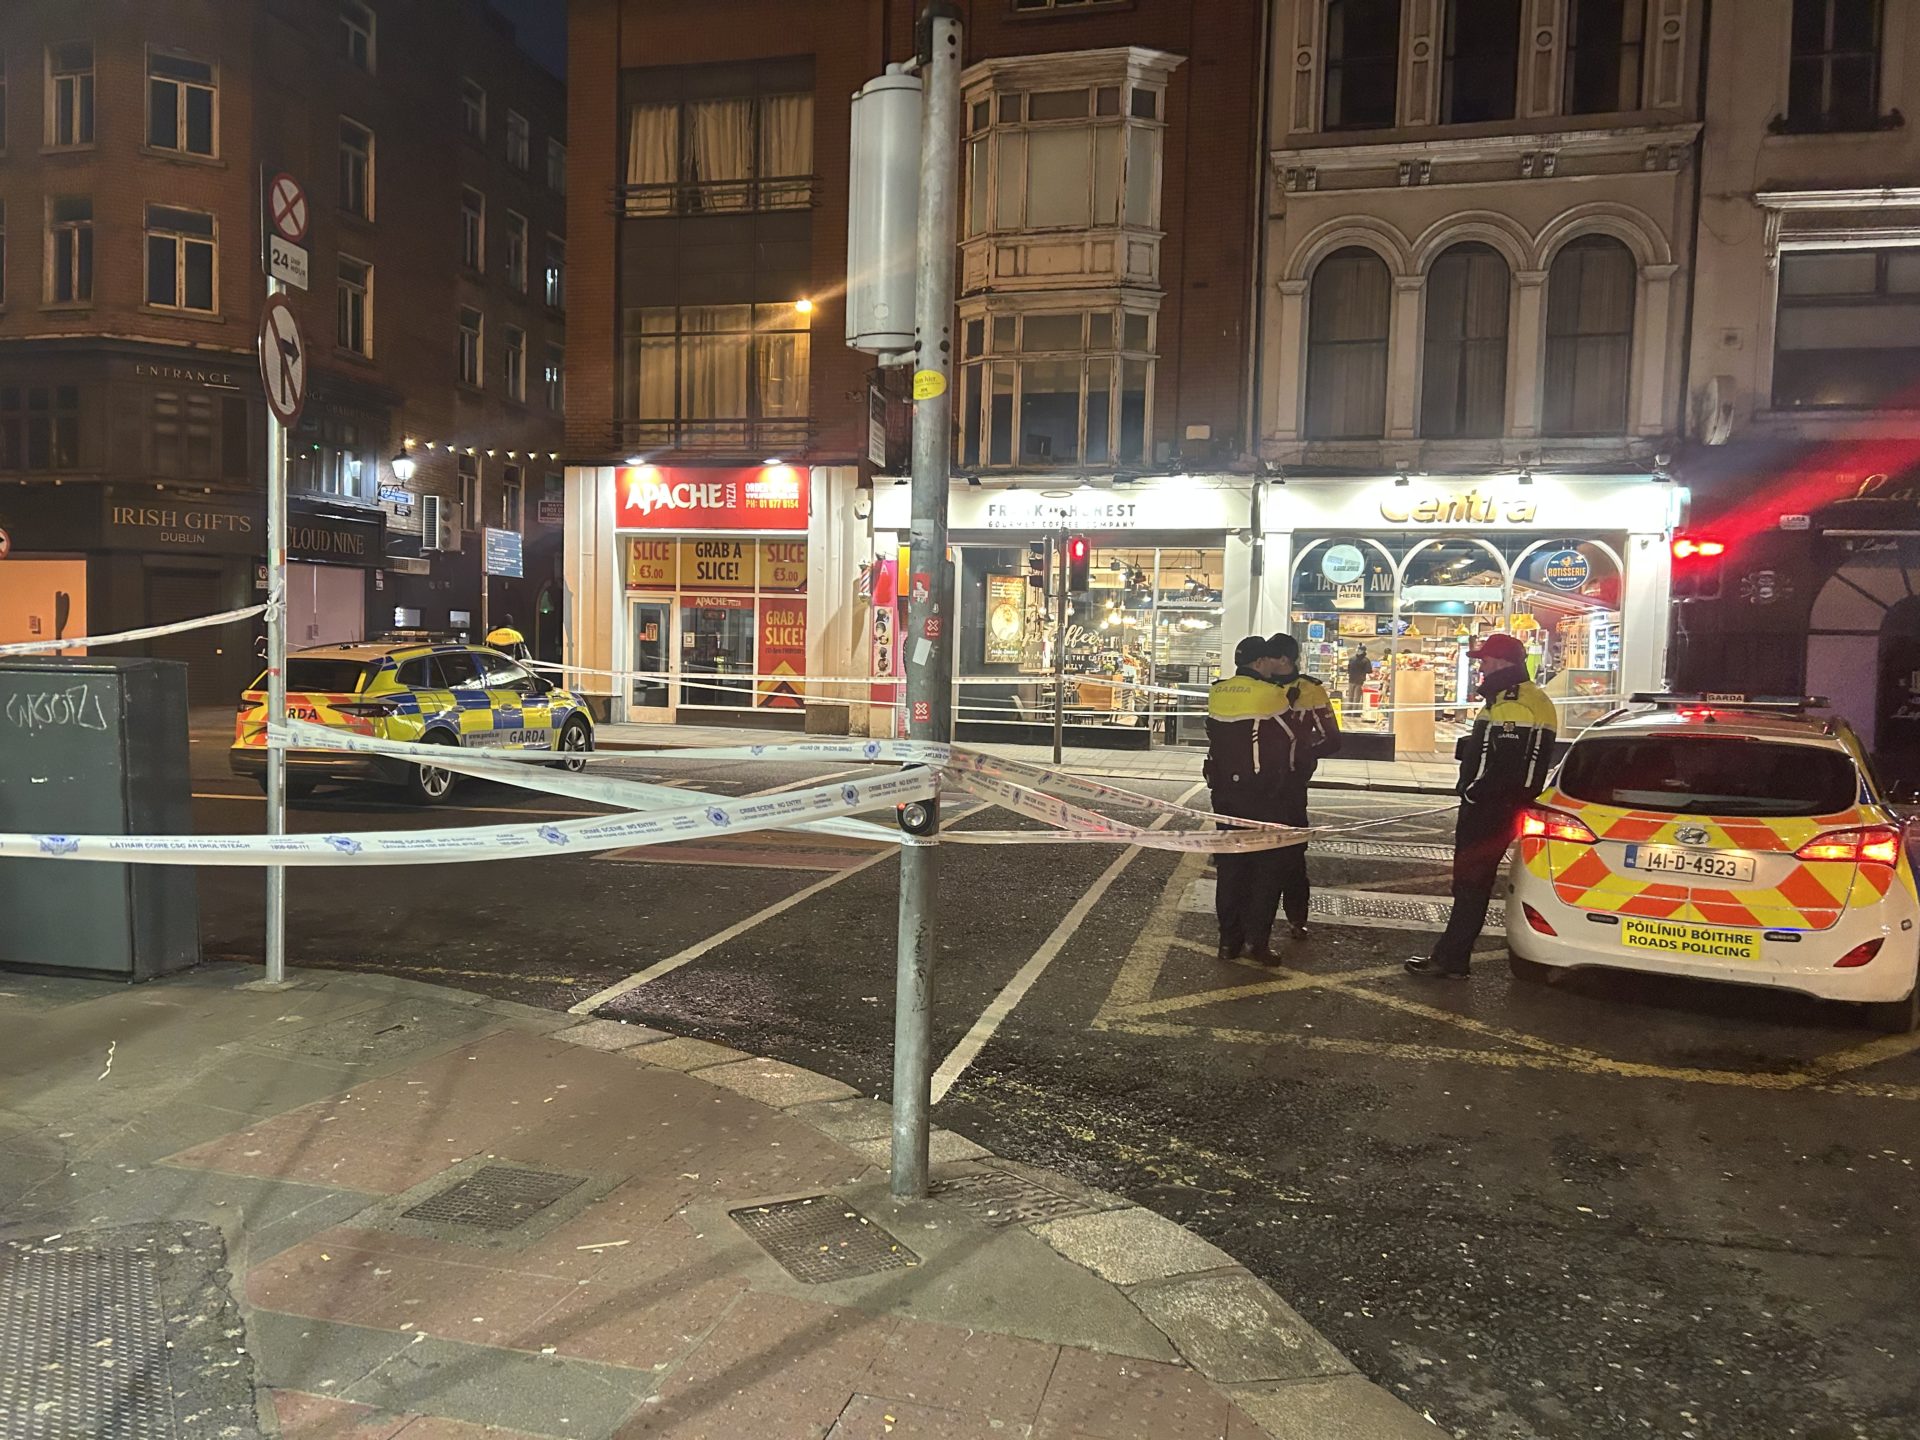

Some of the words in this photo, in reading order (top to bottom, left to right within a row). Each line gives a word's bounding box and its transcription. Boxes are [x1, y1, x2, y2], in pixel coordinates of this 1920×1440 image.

[272, 249, 289, 270] 24
[136, 364, 231, 384] ENTRANCE
[625, 482, 725, 516] APACHE
[726, 482, 737, 509] PIZZA
[745, 500, 758, 509] PH:
[760, 500, 767, 509] 01
[988, 504, 1043, 516] FRK
[1070, 504, 1136, 516] HNEST
[1380, 489, 1537, 523] Centra
[113, 507, 177, 527] IRISH
[184, 512, 252, 533] GIFTS
[160, 532, 205, 543] DUBLIN
[333, 531, 364, 554] NINE
[633, 541, 669, 560] SLICE
[695, 542, 729, 558] GRAB
[733, 542, 742, 558] A
[767, 543, 805, 563] SLICE
[639, 564, 664, 579] €3.00
[697, 561, 739, 580] SLICE!
[773, 567, 798, 582] €3.00
[1547, 567, 1586, 577] ROTISSERIE
[1339, 584, 1362, 592] ATM
[695, 597, 727, 607] APACHE
[766, 610, 793, 625] GRAB
[796, 611, 804, 626] A
[765, 627, 804, 645] SLICE!
[1214, 686, 1252, 694] GARDA
[288, 707, 318, 720] RDA
[509, 730, 545, 743] GARDA
[739, 806, 755, 814] CRIME
[756, 804, 774, 812] SCENE
[1648, 852, 1736, 877] 141-D-4923
[1626, 920, 1686, 938] PÓILÍNIÚ
[1691, 928, 1753, 945] BÓITHRE
[1629, 934, 1677, 950] ROADS
[1682, 941, 1751, 958] POLICING
